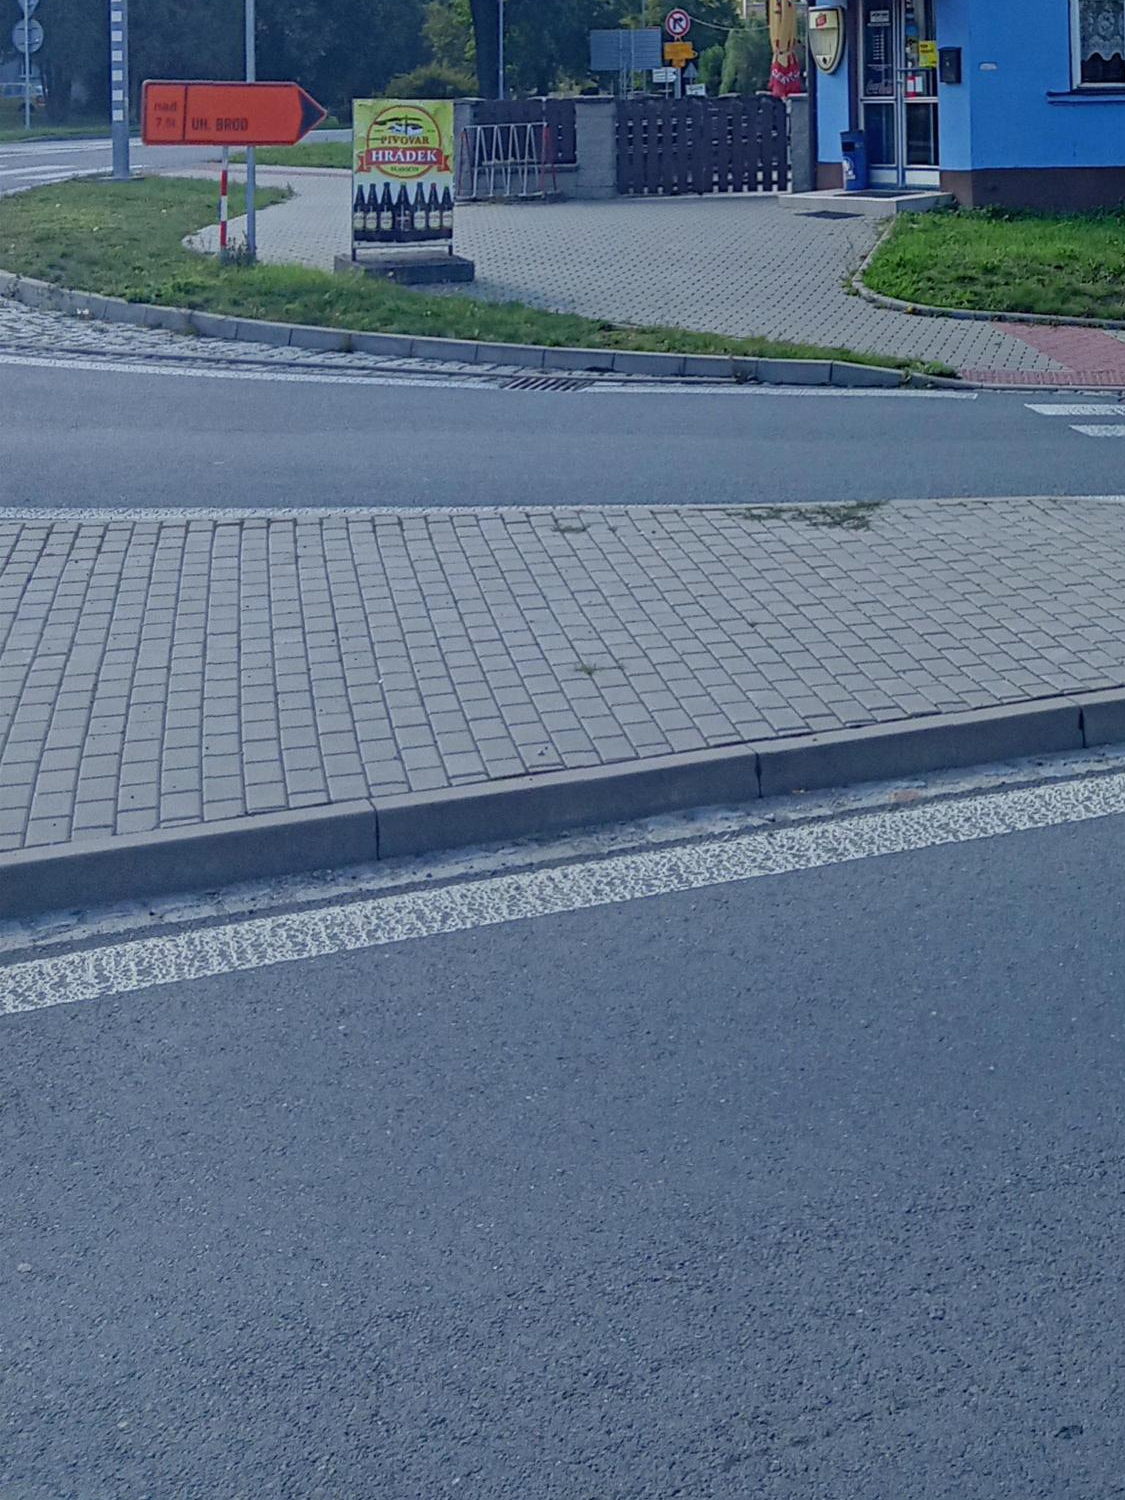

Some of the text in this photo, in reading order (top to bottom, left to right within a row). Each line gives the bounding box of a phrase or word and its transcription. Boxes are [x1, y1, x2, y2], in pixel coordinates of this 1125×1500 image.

[191, 117, 249, 132] UH. BROD
[381, 135, 429, 146] PIVOVAR
[371, 148, 438, 163] HRÁDEK
